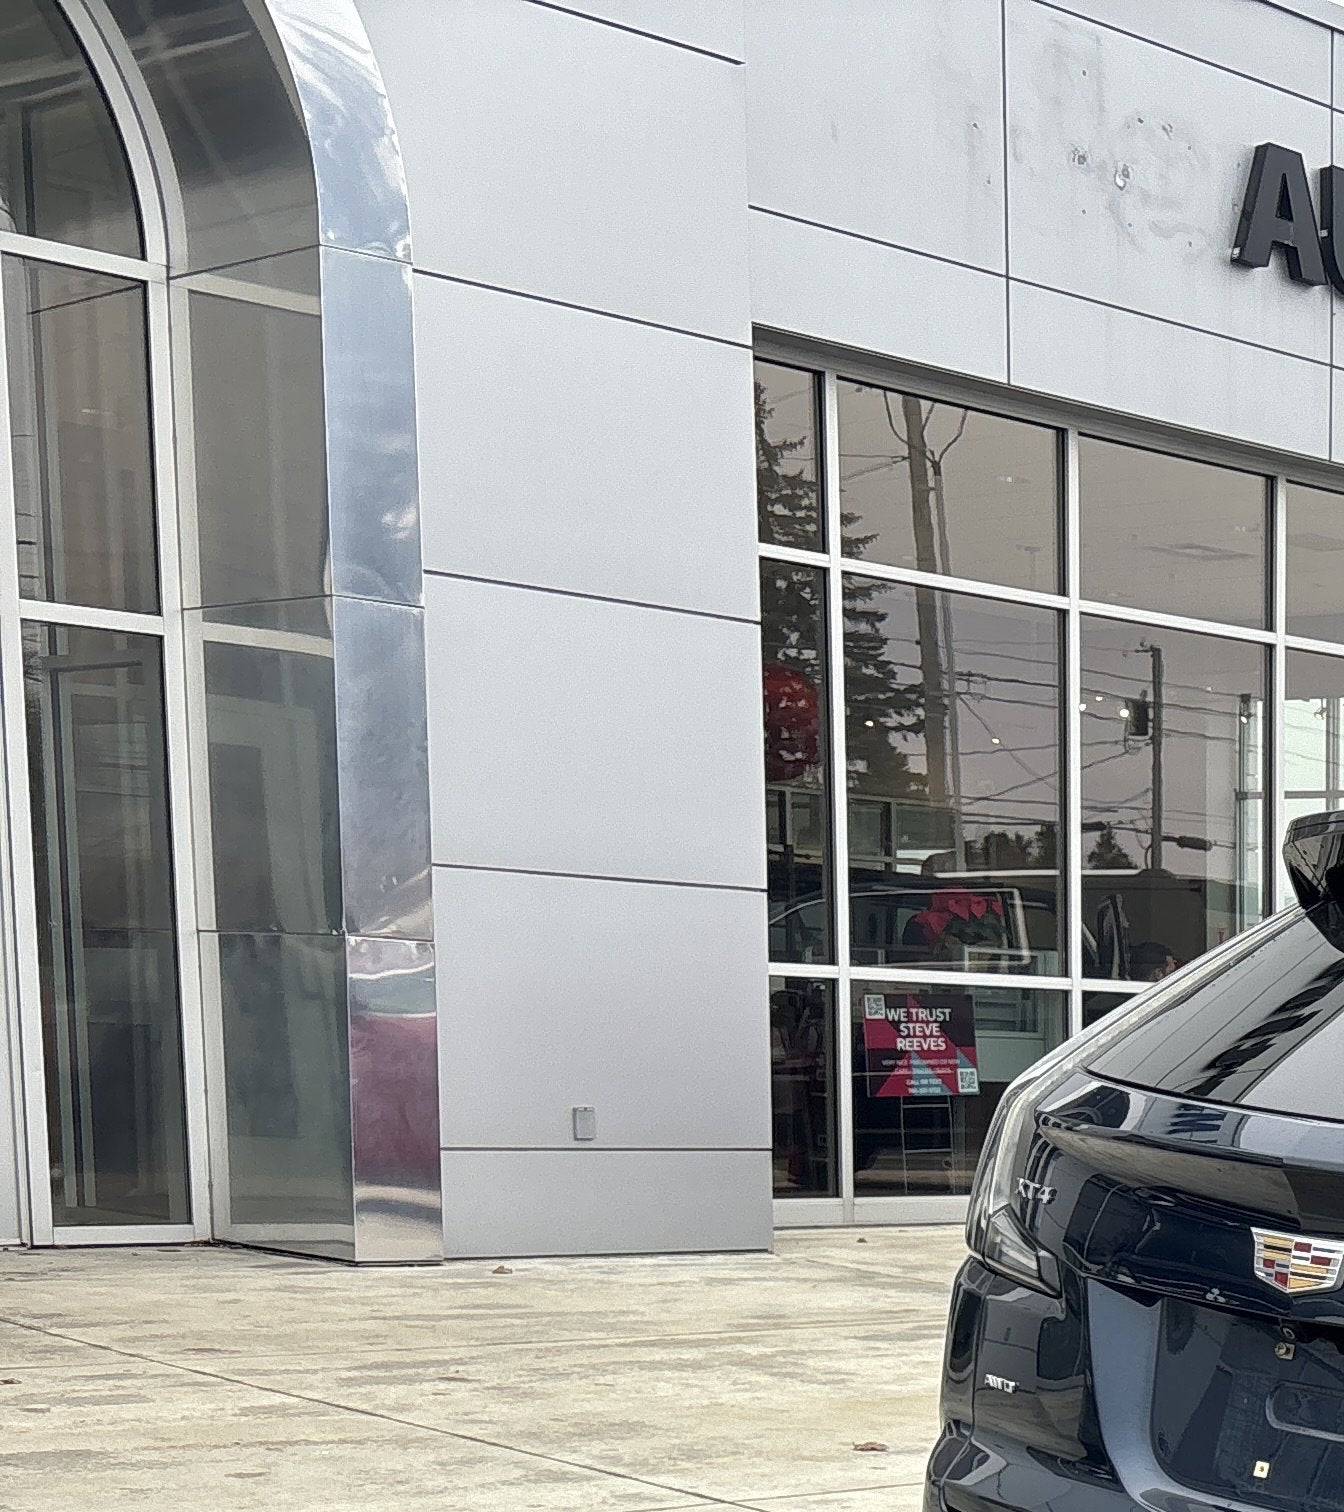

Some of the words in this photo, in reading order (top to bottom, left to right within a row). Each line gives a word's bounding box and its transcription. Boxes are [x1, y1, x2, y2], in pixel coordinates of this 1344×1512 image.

[886, 1008, 908, 1022] WE
[909, 1008, 952, 1022] TRUST
[899, 1023, 941, 1037] STEVE
[896, 1037, 947, 1051] REEVES
[1014, 1177, 1057, 1205] XT4
